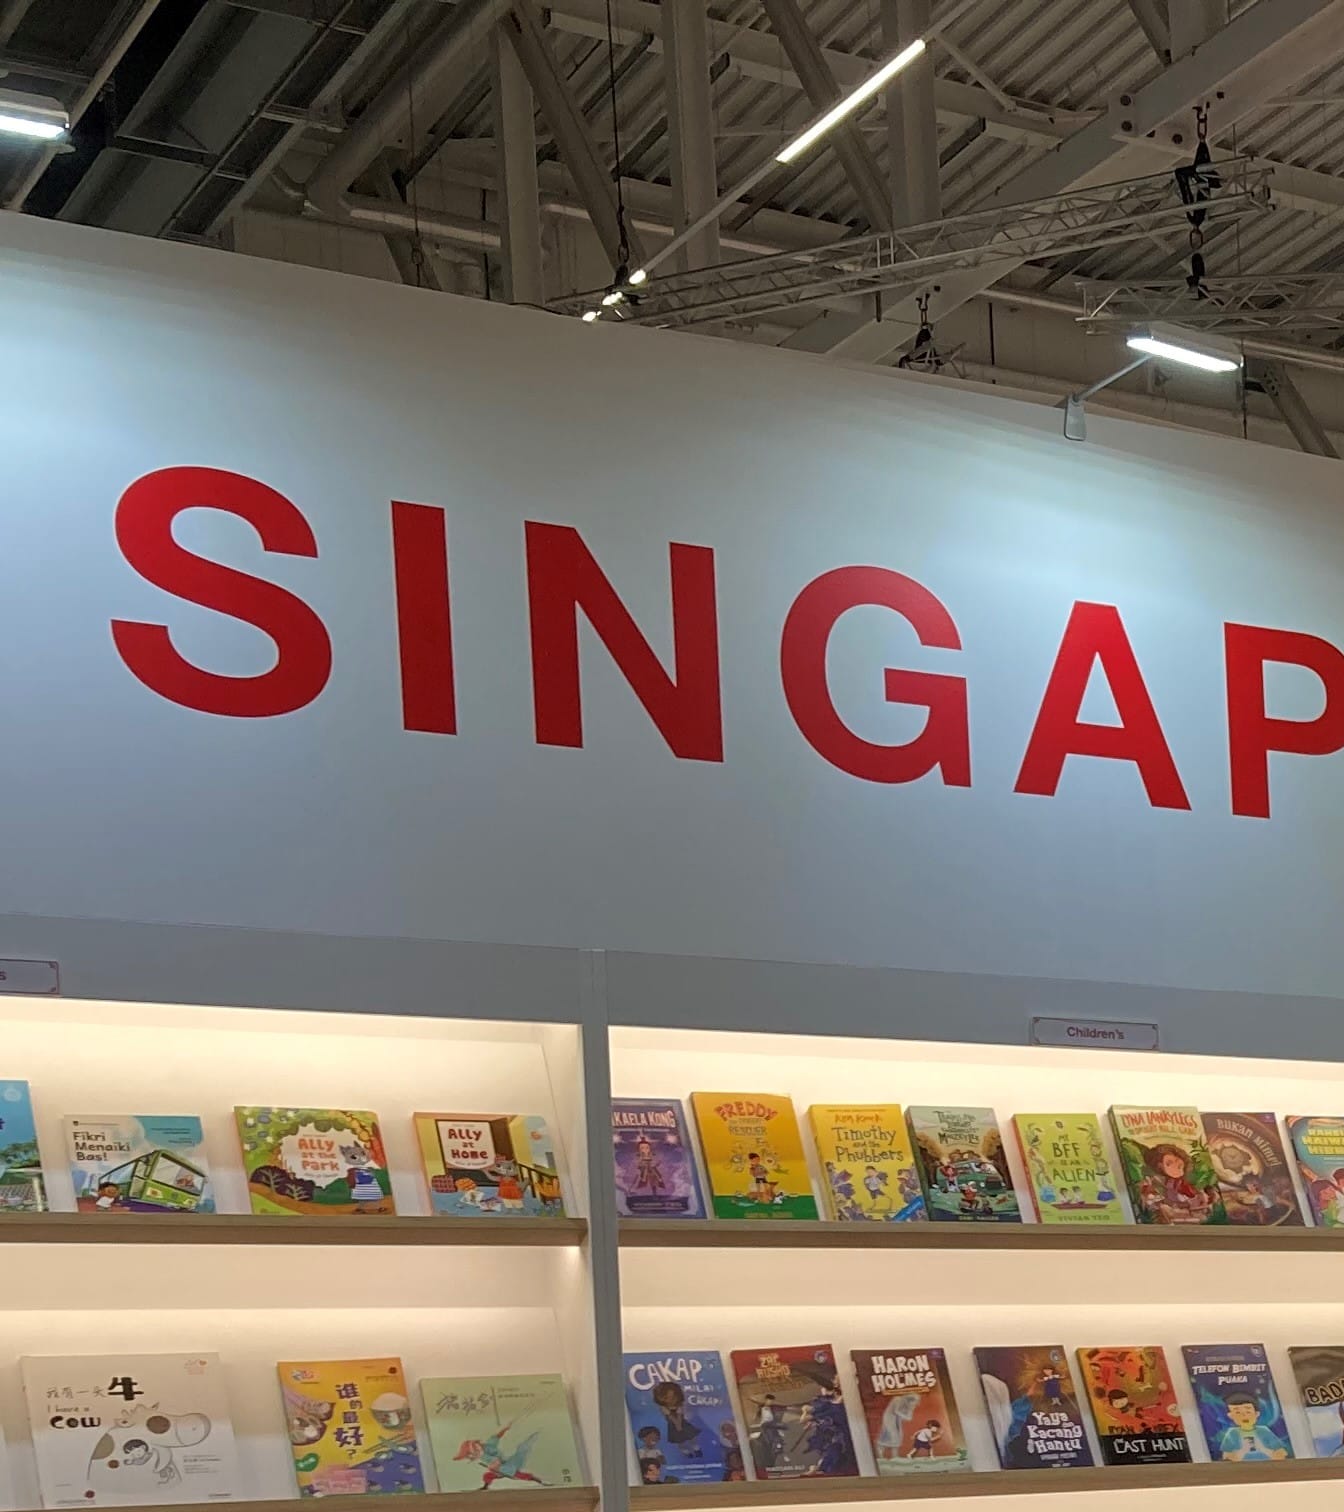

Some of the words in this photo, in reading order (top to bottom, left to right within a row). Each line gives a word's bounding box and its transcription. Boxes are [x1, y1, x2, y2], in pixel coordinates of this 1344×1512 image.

[1066, 1026, 1125, 1040] Children's
[649, 1110, 676, 1128] KONG
[713, 1102, 777, 1122] FREDDY
[73, 1132, 106, 1141] Fikri
[448, 1128, 483, 1141] Ally
[831, 1126, 897, 1146] Timothy
[75, 1142, 131, 1152] Menaiki
[298, 1138, 335, 1151] Ally
[1052, 1142, 1081, 1158] BFF
[76, 1152, 108, 1161] Bas!
[450, 1149, 490, 1161] Home
[835, 1146, 904, 1163] Phubbers
[301, 1160, 340, 1172] Park
[1052, 1168, 1096, 1182] ALIEN
[871, 1354, 930, 1374] HARON
[629, 1358, 703, 1391] CAKAP
[871, 1371, 937, 1392] HOLMES
[1031, 1412, 1068, 1426] Yaya
[1035, 1439, 1081, 1453] Hantu
[1152, 1437, 1185, 1452] HUNT
